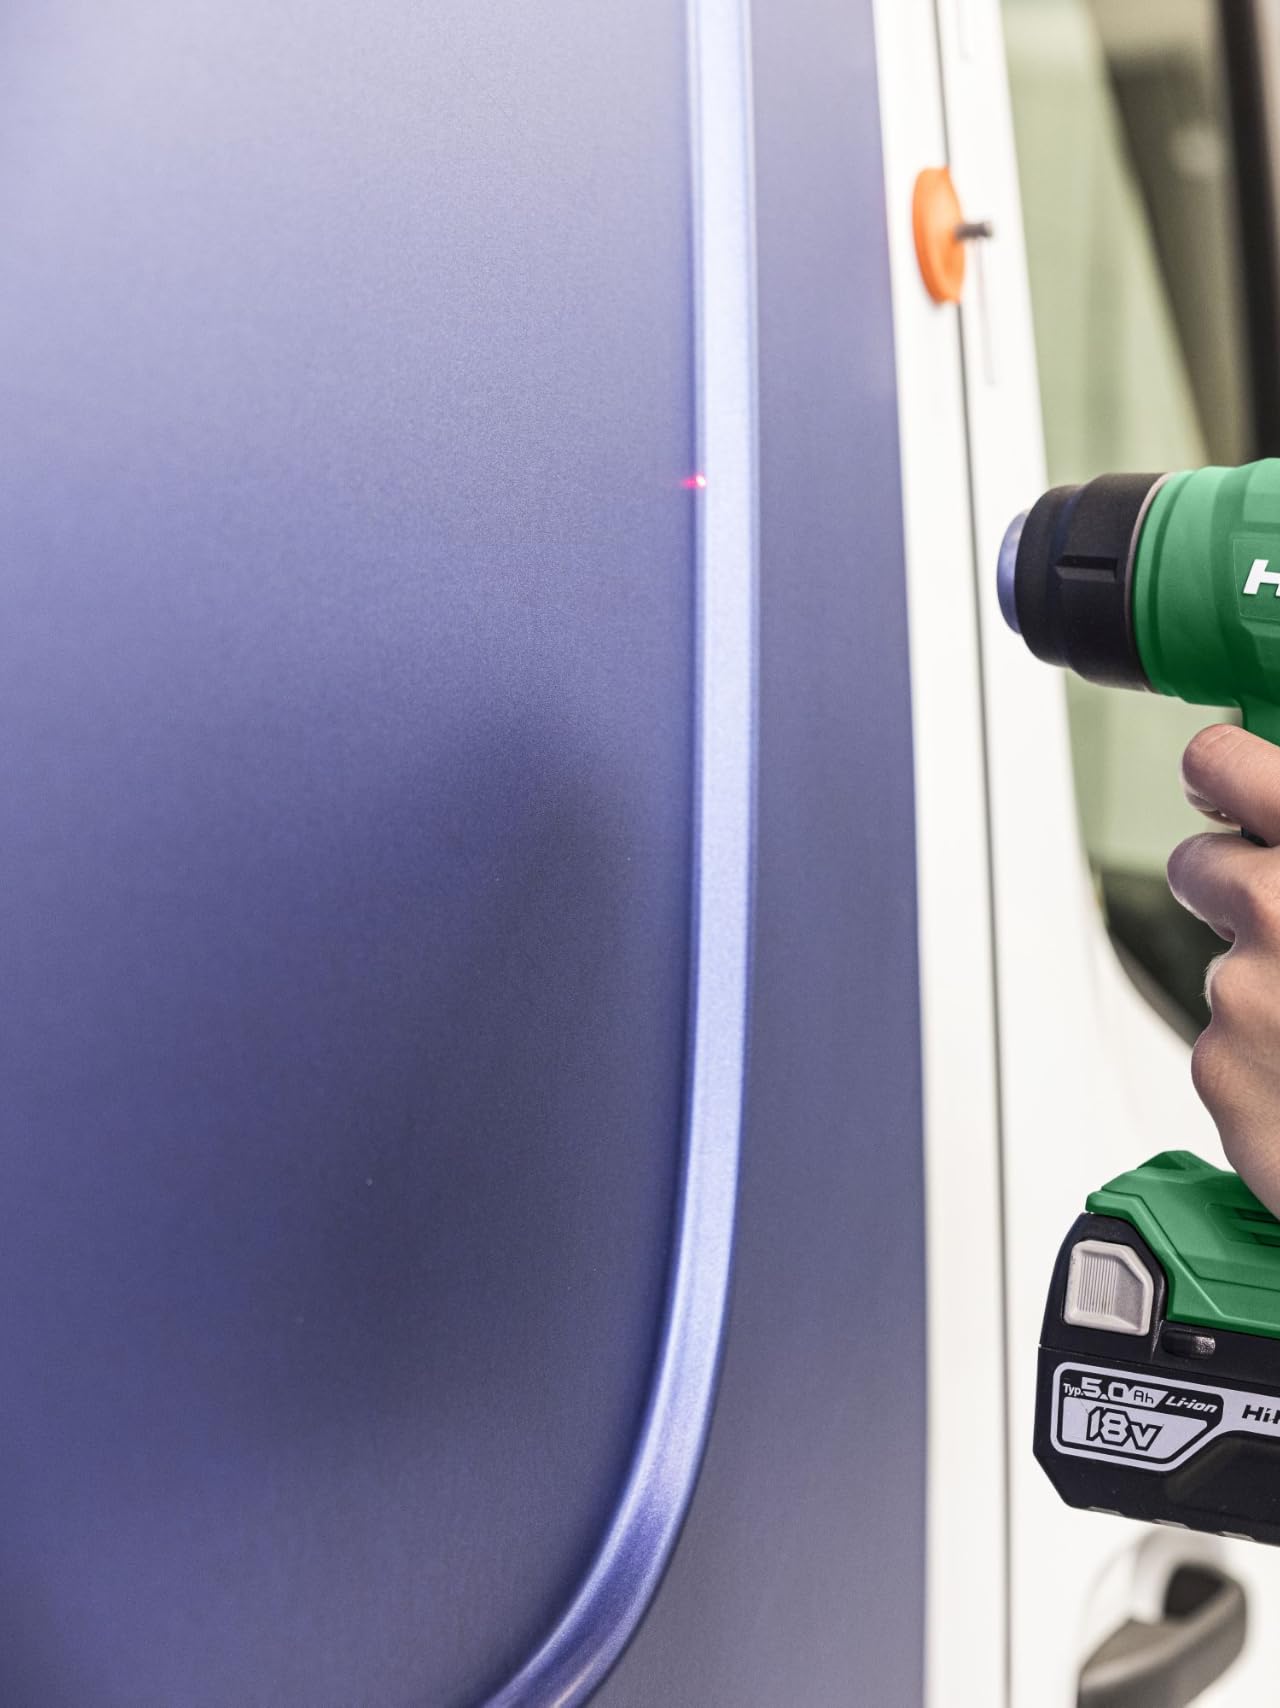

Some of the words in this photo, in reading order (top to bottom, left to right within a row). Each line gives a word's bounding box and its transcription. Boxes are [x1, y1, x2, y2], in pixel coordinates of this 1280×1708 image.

[1063, 1382, 1083, 1396] Typ.
[1081, 1377, 1130, 1401] 5.0
[1133, 1390, 1154, 1404] Ah
[1165, 1396, 1218, 1413] Li-ion
